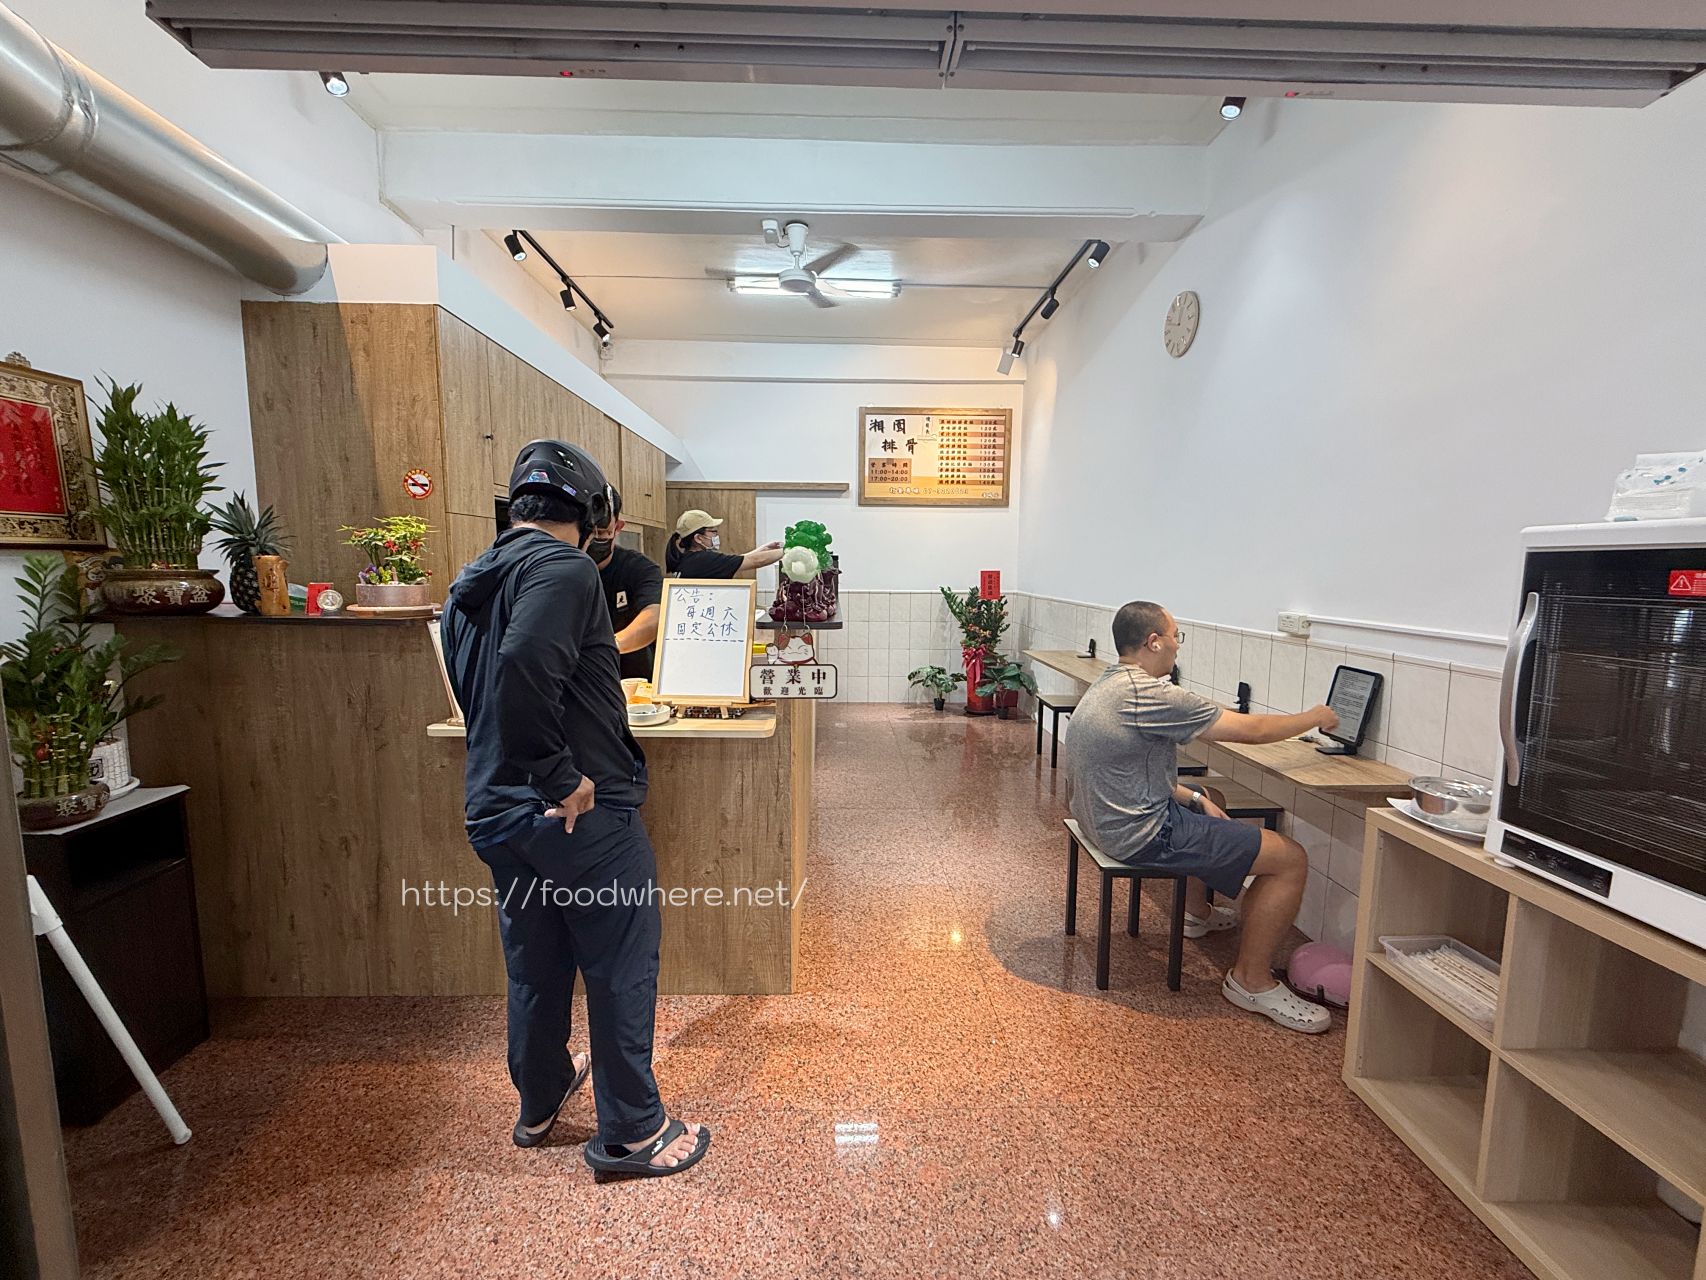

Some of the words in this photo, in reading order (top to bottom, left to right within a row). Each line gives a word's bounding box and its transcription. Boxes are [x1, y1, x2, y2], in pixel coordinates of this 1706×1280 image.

[881, 437, 918, 455] 排骨
[760, 668, 826, 685] 營業中
[763, 686, 824, 696] 歡迎光臨
